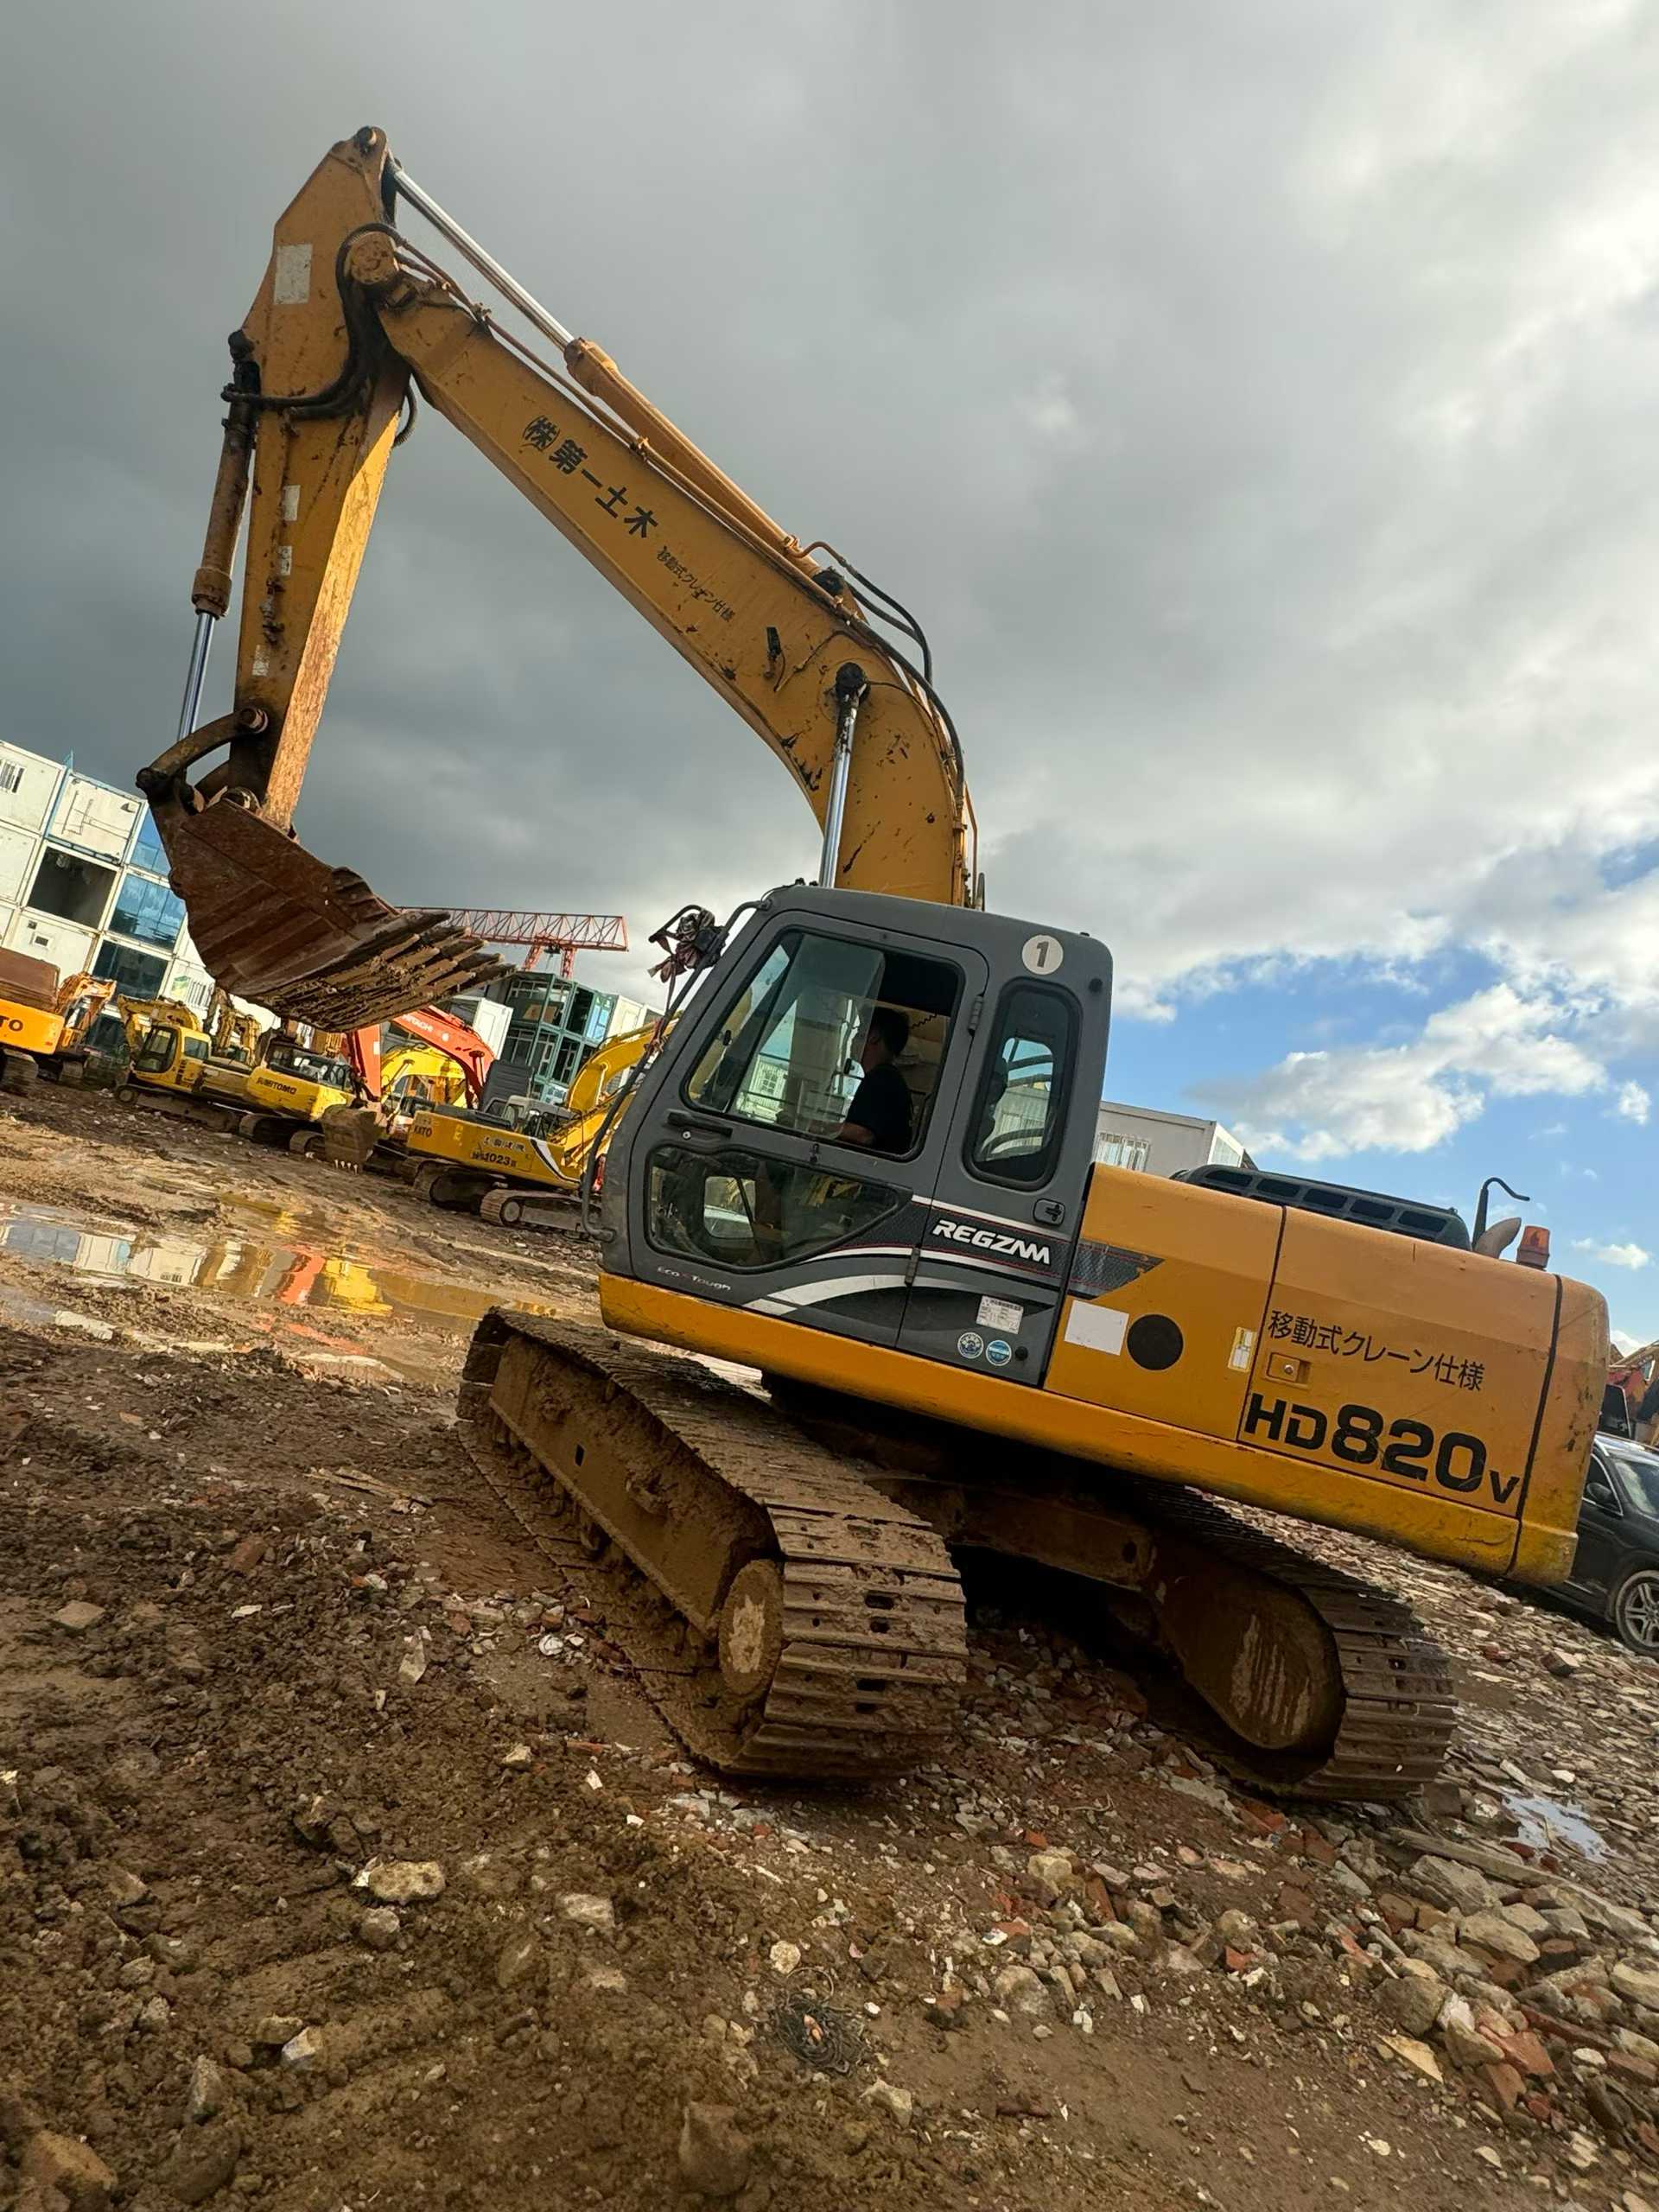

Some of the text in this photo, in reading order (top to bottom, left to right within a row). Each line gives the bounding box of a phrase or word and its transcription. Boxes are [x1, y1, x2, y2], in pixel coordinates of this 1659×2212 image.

[1037, 941, 1049, 968] 1
[932, 1219, 1051, 1265] REGZAM
[1268, 1309, 1486, 1392] 移動式クレーン仕様
